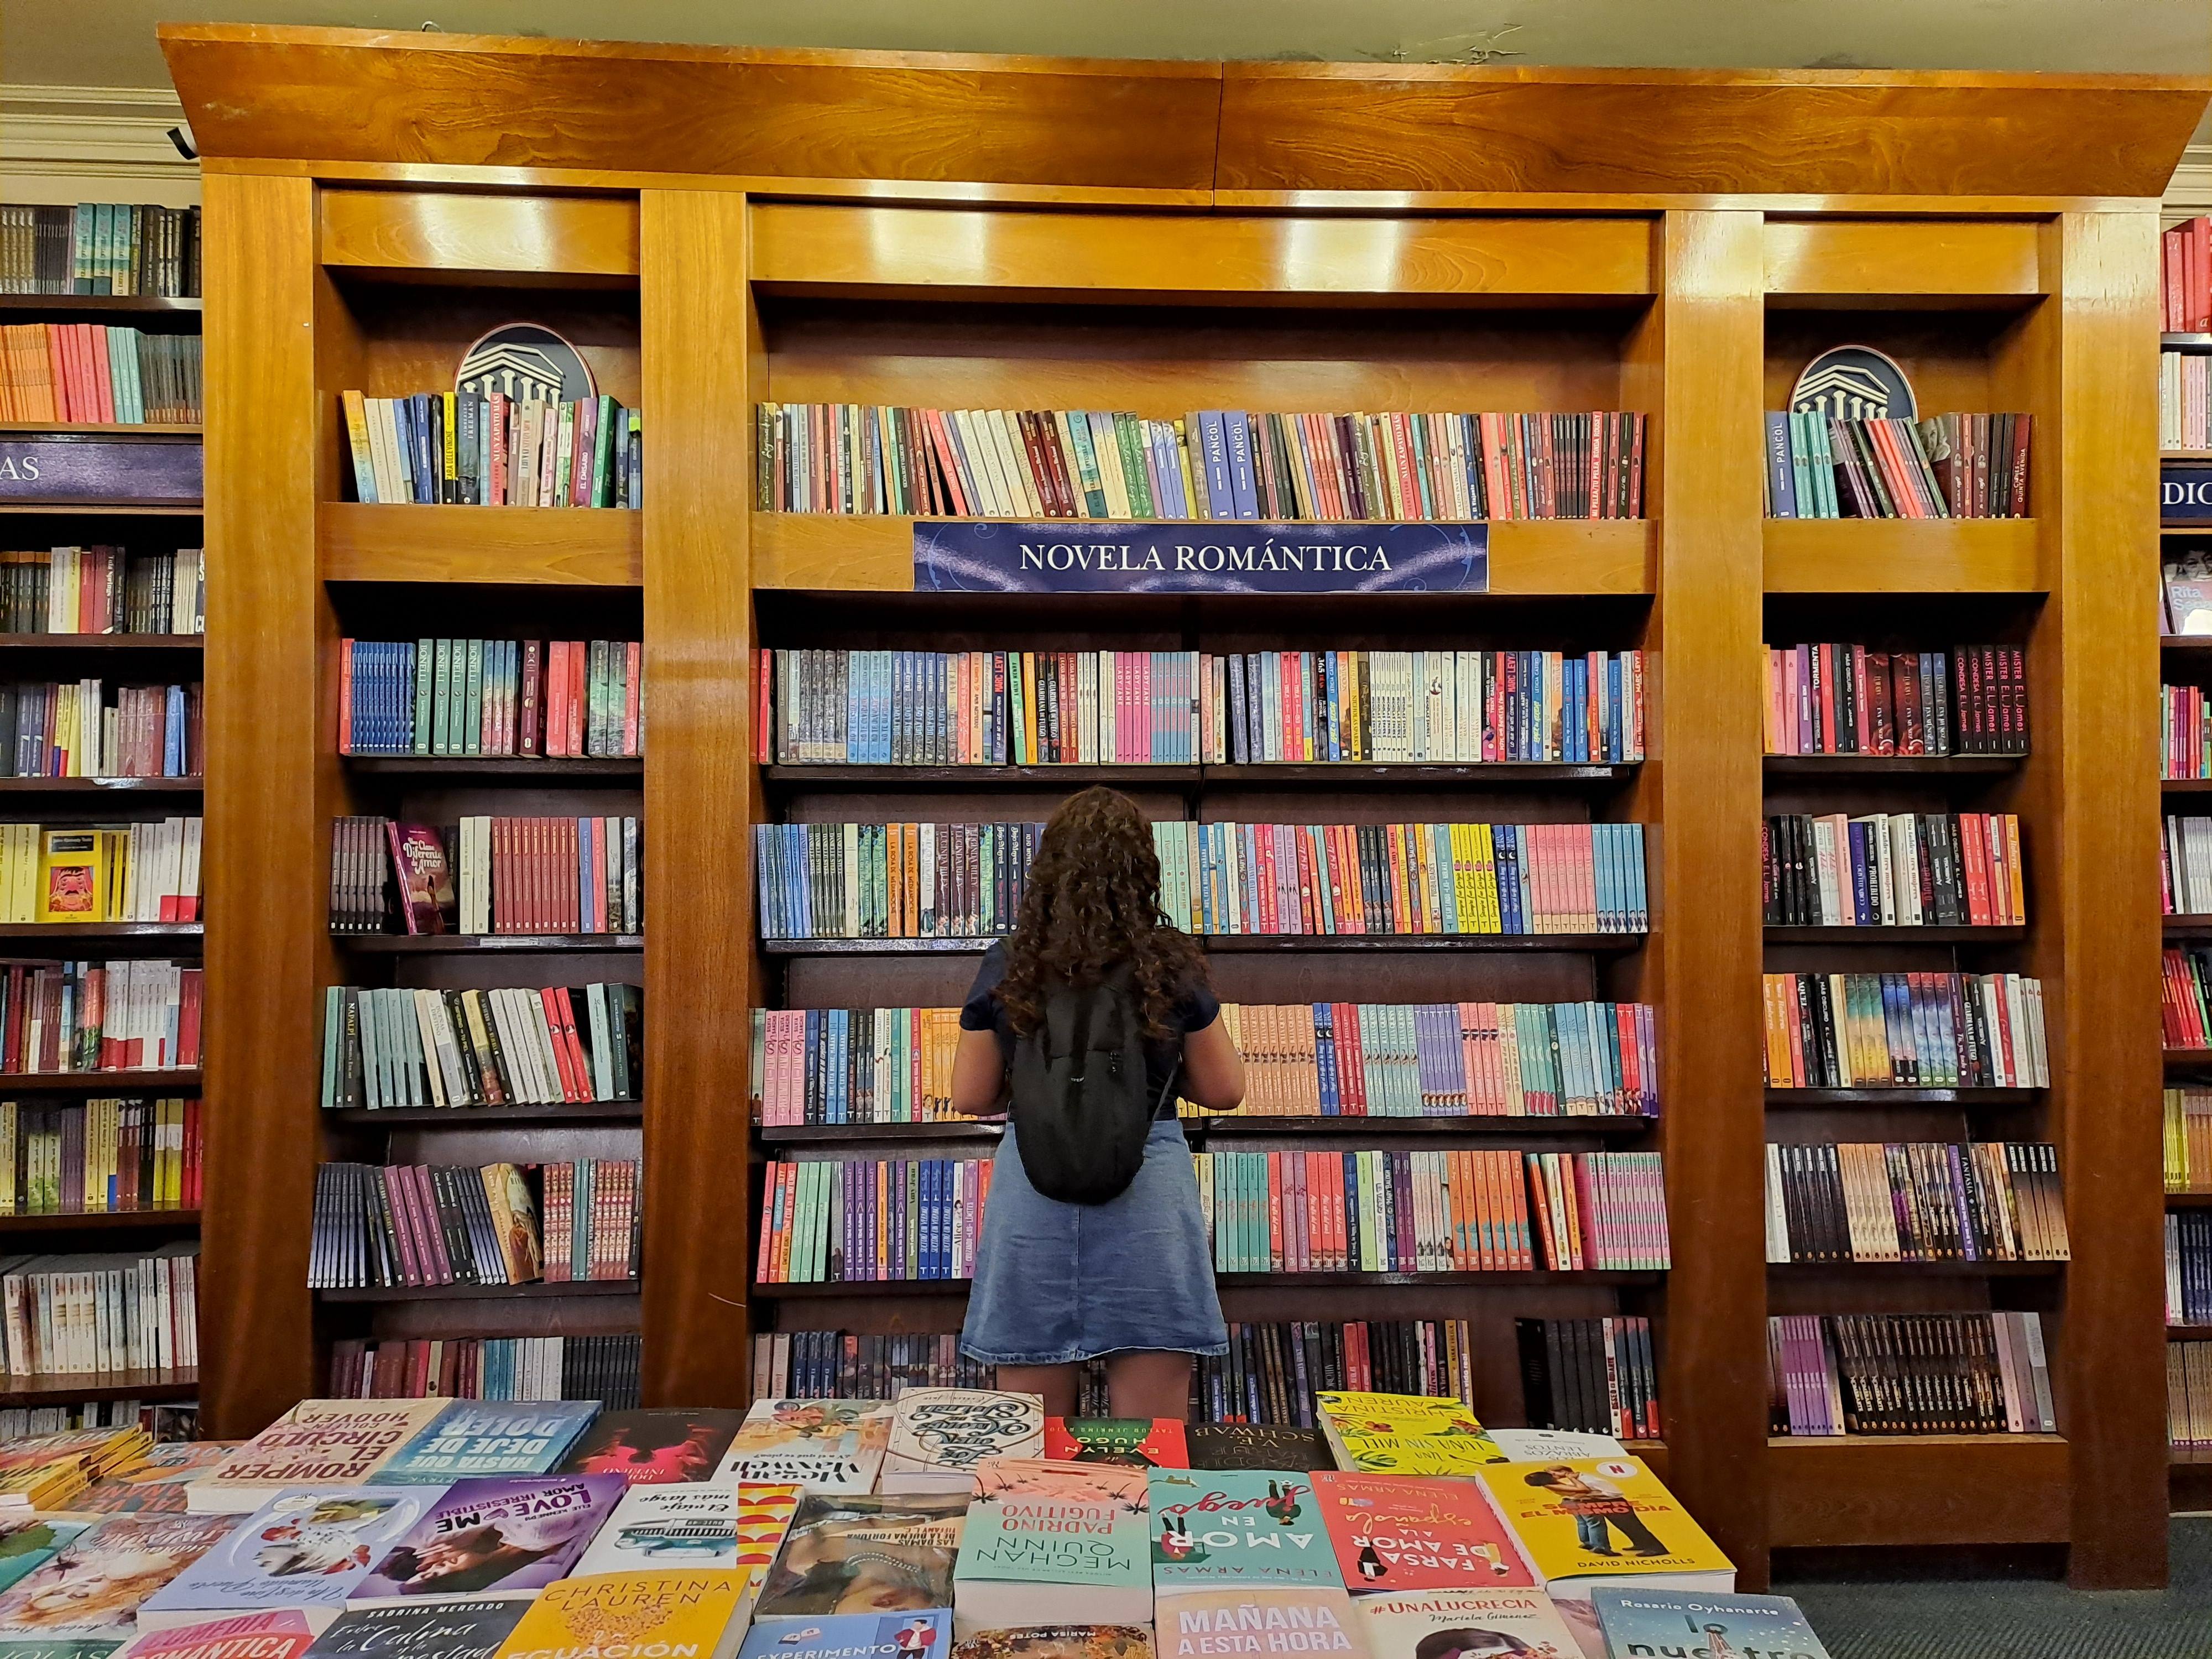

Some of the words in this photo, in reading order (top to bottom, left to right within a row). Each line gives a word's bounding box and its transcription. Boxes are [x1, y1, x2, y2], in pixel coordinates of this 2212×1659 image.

[1209, 421, 1221, 462] PANCOL
[1233, 421, 1245, 462] PANCOL
[1773, 422, 1786, 463] PANCOL
[1019, 544, 1165, 570] NOVELA
[1175, 539, 1393, 572] ROMÁNTICA
[419, 645, 427, 682] BONELLI
[437, 645, 445, 682] BONELLI
[469, 645, 477, 682] BONELLI
[994, 655, 1004, 673] LEVY
[1507, 655, 1515, 673] LEVY
[1985, 651, 1994, 680] MISTER
[2013, 650, 2022, 680] MISTER
[994, 675, 1004, 693] MARC
[1507, 675, 1516, 692] MARC
[1987, 703, 1996, 732] James
[2016, 703, 2025, 732] James
[403, 843, 442, 859] Diferente
[415, 858, 442, 874] Amor
[1869, 865, 1879, 906] PROHIBIDO
[1346, 1397, 1438, 1408] LAUREN
[302, 1412, 410, 1423] HOOVER
[1334, 1405, 1463, 1418] CHRISTINA
[439, 1410, 565, 1437] DOLER
[1194, 1426, 1315, 1442] SCHWAB
[419, 1438, 469, 1454] DE
[466, 1438, 550, 1454] DEJE
[1064, 1446, 1160, 1454] EVELYN
[1359, 1438, 1400, 1450] MIEL
[1405, 1438, 1434, 1449] SIN
[1437, 1439, 1485, 1452] LUNA
[349, 1446, 388, 1461] EL
[405, 1455, 454, 1468] QUE
[456, 1456, 534, 1468] HASTA
[730, 1462, 864, 1474] Maxwell
[1609, 1465, 1625, 1474] N
[217, 1462, 372, 1479] ROMPER
[741, 1470, 851, 1483] Megan
[541, 1483, 585, 1497] AMOR
[1336, 1484, 1396, 1494] ARMAS
[435, 1493, 536, 1520] IRRESISTIBLE
[513, 1489, 592, 1517] LOVE
[639, 1494, 687, 1503] largo
[1157, 1485, 1311, 1517] juego
[1542, 1500, 1644, 1511] SIEMPRE
[659, 1502, 706, 1512] viaje
[707, 1504, 730, 1512] El
[1001, 1505, 1115, 1521] FUGITIVO
[1520, 1510, 1549, 1519] EL
[1553, 1505, 1630, 1515] MISMO
[435, 1513, 481, 1533] ME
[1001, 1519, 1113, 1535] PADRINO
[1221, 1516, 1256, 1527] EN
[1345, 1503, 1472, 1536] española
[1166, 1530, 1314, 1550] AMOR
[1398, 1528, 1418, 1537] LA
[997, 1536, 1115, 1557] QUINN
[1350, 1535, 1442, 1553] AMOR
[1452, 1543, 1491, 1558] DE
[976, 1548, 1130, 1571] MEGHAN
[1381, 1551, 1475, 1572] FARSA
[1624, 1557, 1695, 1567] NICHOLLS
[1163, 1566, 1244, 1575] ARMAS
[1258, 1567, 1332, 1578] ELENA
[544, 1580, 731, 1602] CHRISTINA
[561, 1593, 702, 1611] LAUREN
[1619, 1599, 1682, 1611] Rosario
[1687, 1603, 1779, 1615] Oyhanarte
[367, 1606, 430, 1619] SABRINA
[436, 1603, 505, 1614] MERCADO
[1428, 1614, 1483, 1623] Mariela
[1178, 1604, 1342, 1635] MAÑANA
[1684, 1614, 1728, 1635] lo
[145, 1612, 278, 1648] COMEDIA
[1009, 1631, 1047, 1640] POTES
[1178, 1636, 1195, 1656] A
[1199, 1635, 1263, 1655] ESTA
[1266, 1631, 1354, 1652] HORA
